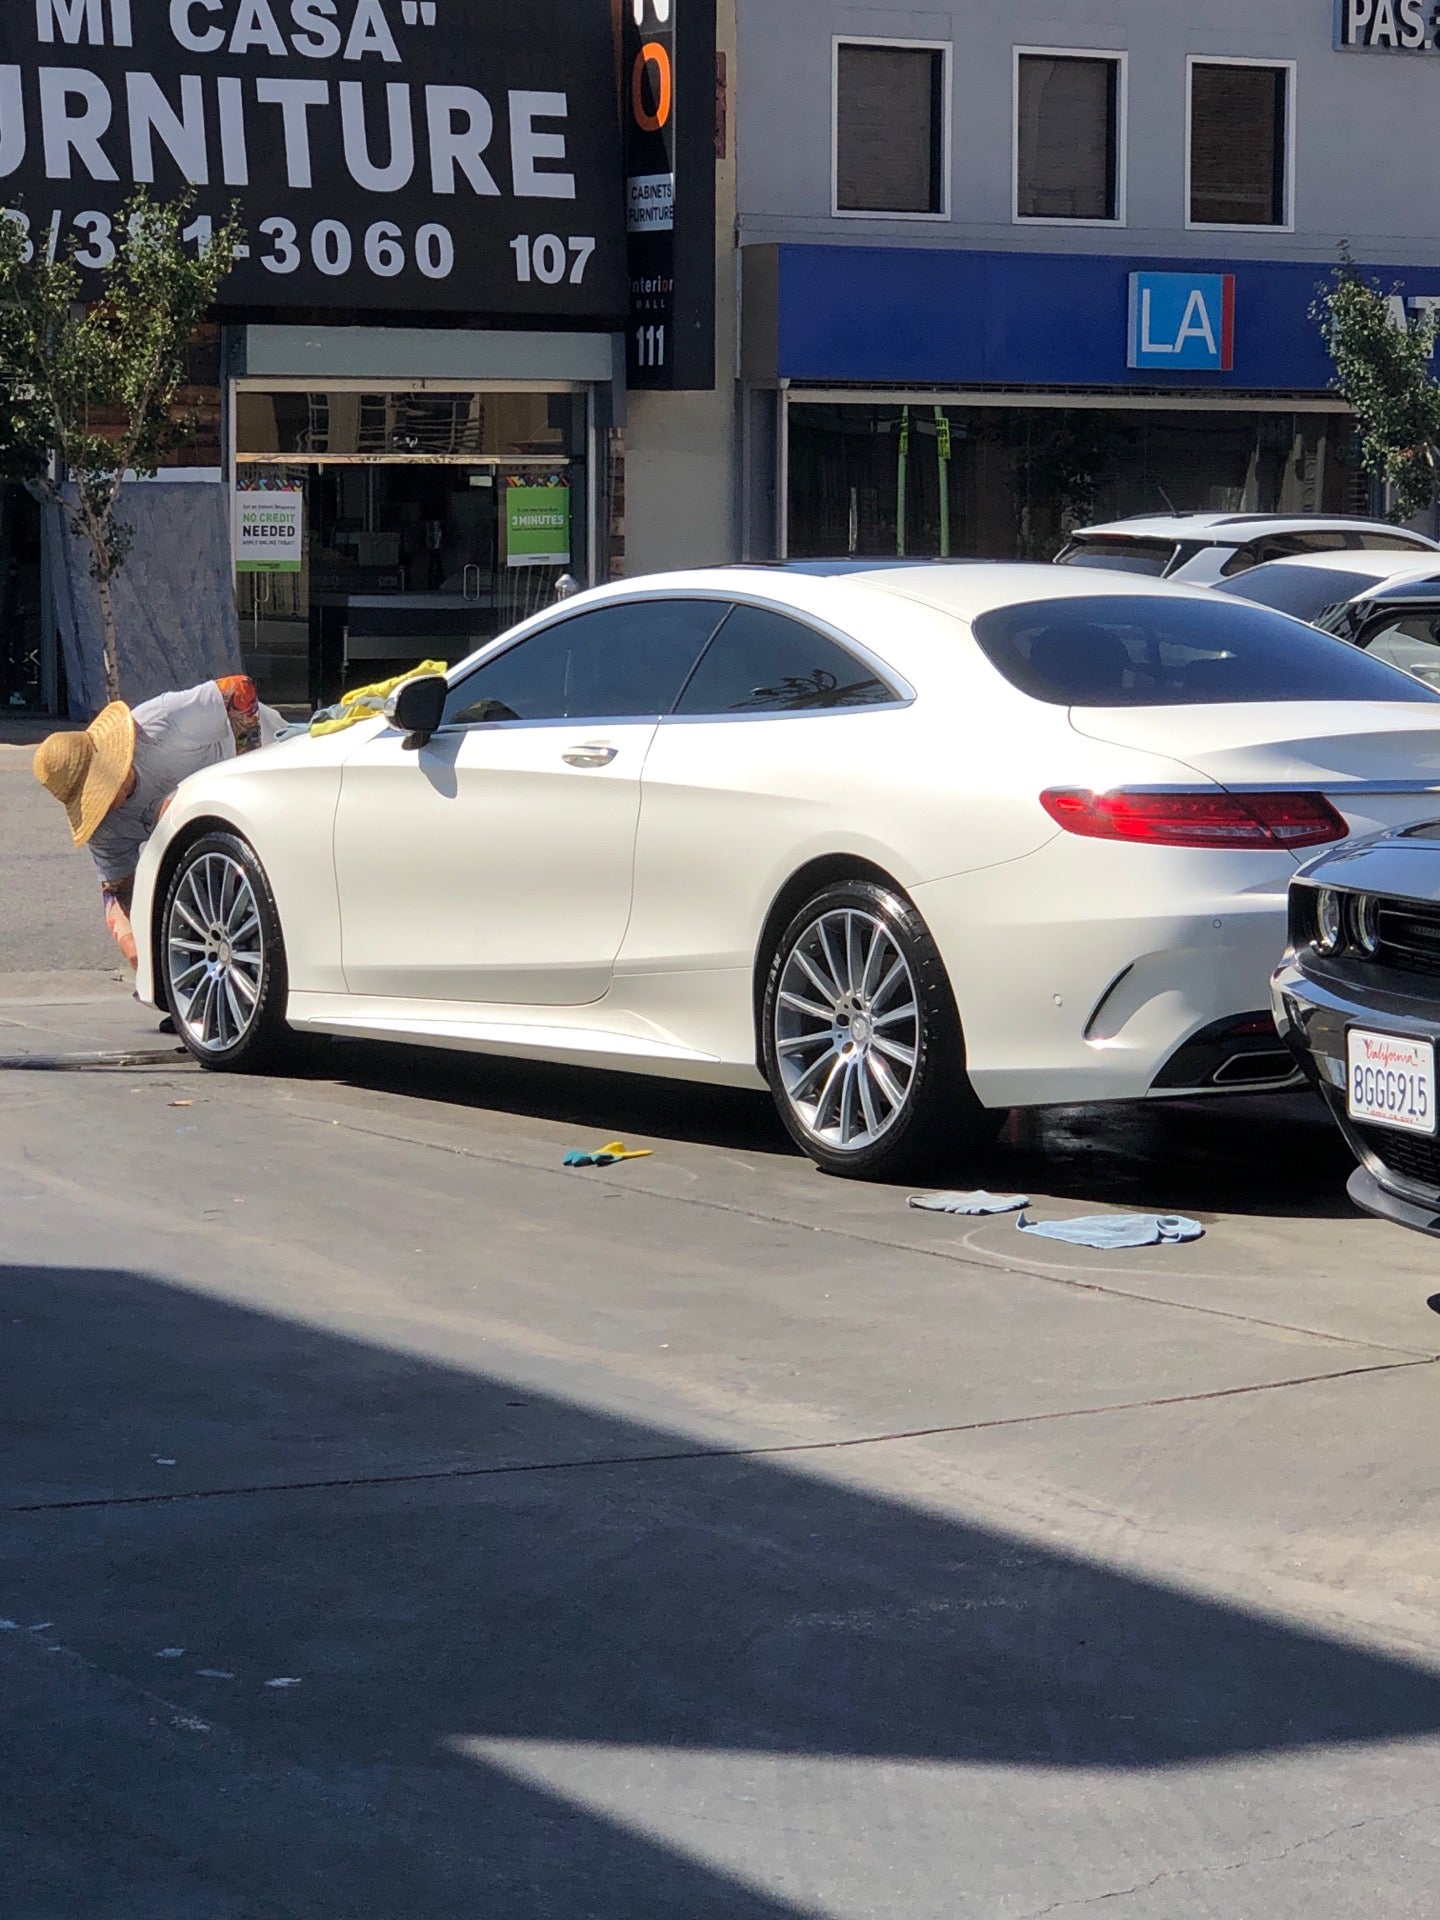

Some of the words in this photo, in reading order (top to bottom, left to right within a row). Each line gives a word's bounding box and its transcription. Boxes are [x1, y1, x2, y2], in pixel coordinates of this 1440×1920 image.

[36, 0, 132, 47] MI
[631, 184, 672, 200] CABINETS
[629, 205, 674, 222] FURNITURE
[510, 233, 595, 284] 107
[627, 275, 673, 293] nterior
[1142, 288, 1217, 354] LA
[636, 325, 664, 366] 111
[243, 513, 257, 523] NO
[260, 513, 296, 523] CREDIT
[512, 515, 518, 526] 3
[519, 514, 564, 526] MINUTES
[242, 525, 295, 537] NEEDED
[1363, 1039, 1418, 1068] California
[1354, 1064, 1427, 1117] 8GGG915
